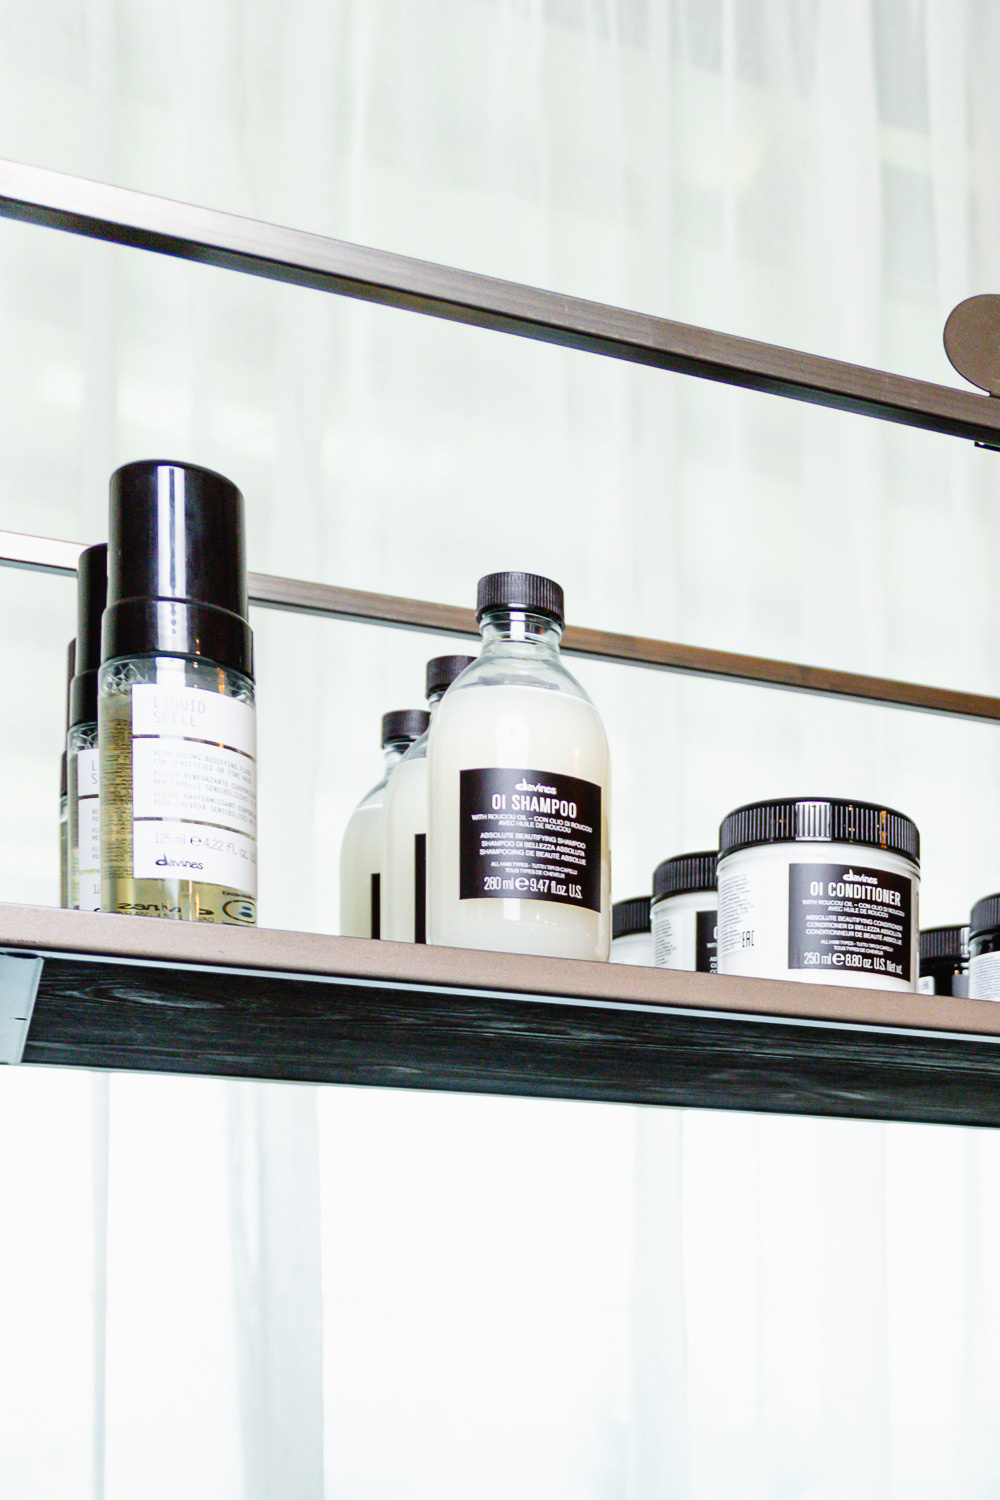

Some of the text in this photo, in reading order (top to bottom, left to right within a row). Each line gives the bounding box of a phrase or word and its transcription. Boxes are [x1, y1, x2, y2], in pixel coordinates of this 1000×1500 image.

[153, 697, 206, 714] LIQUID
[153, 712, 198, 727] SPELL
[515, 778, 557, 795] davines
[492, 794, 577, 818] OI SHAMPOO
[515, 833, 556, 843] BEAUTIFYING
[558, 838, 586, 849] SHAMPOO
[524, 842, 555, 850] BELLEZZA
[155, 854, 203, 869] davines
[484, 877, 501, 890] 280
[503, 877, 514, 890] ml
[530, 878, 549, 892] 9.47
[843, 869, 878, 885] davines
[810, 881, 901, 907] OI CONDITIONER
[804, 952, 861, 967] 250 8.80
